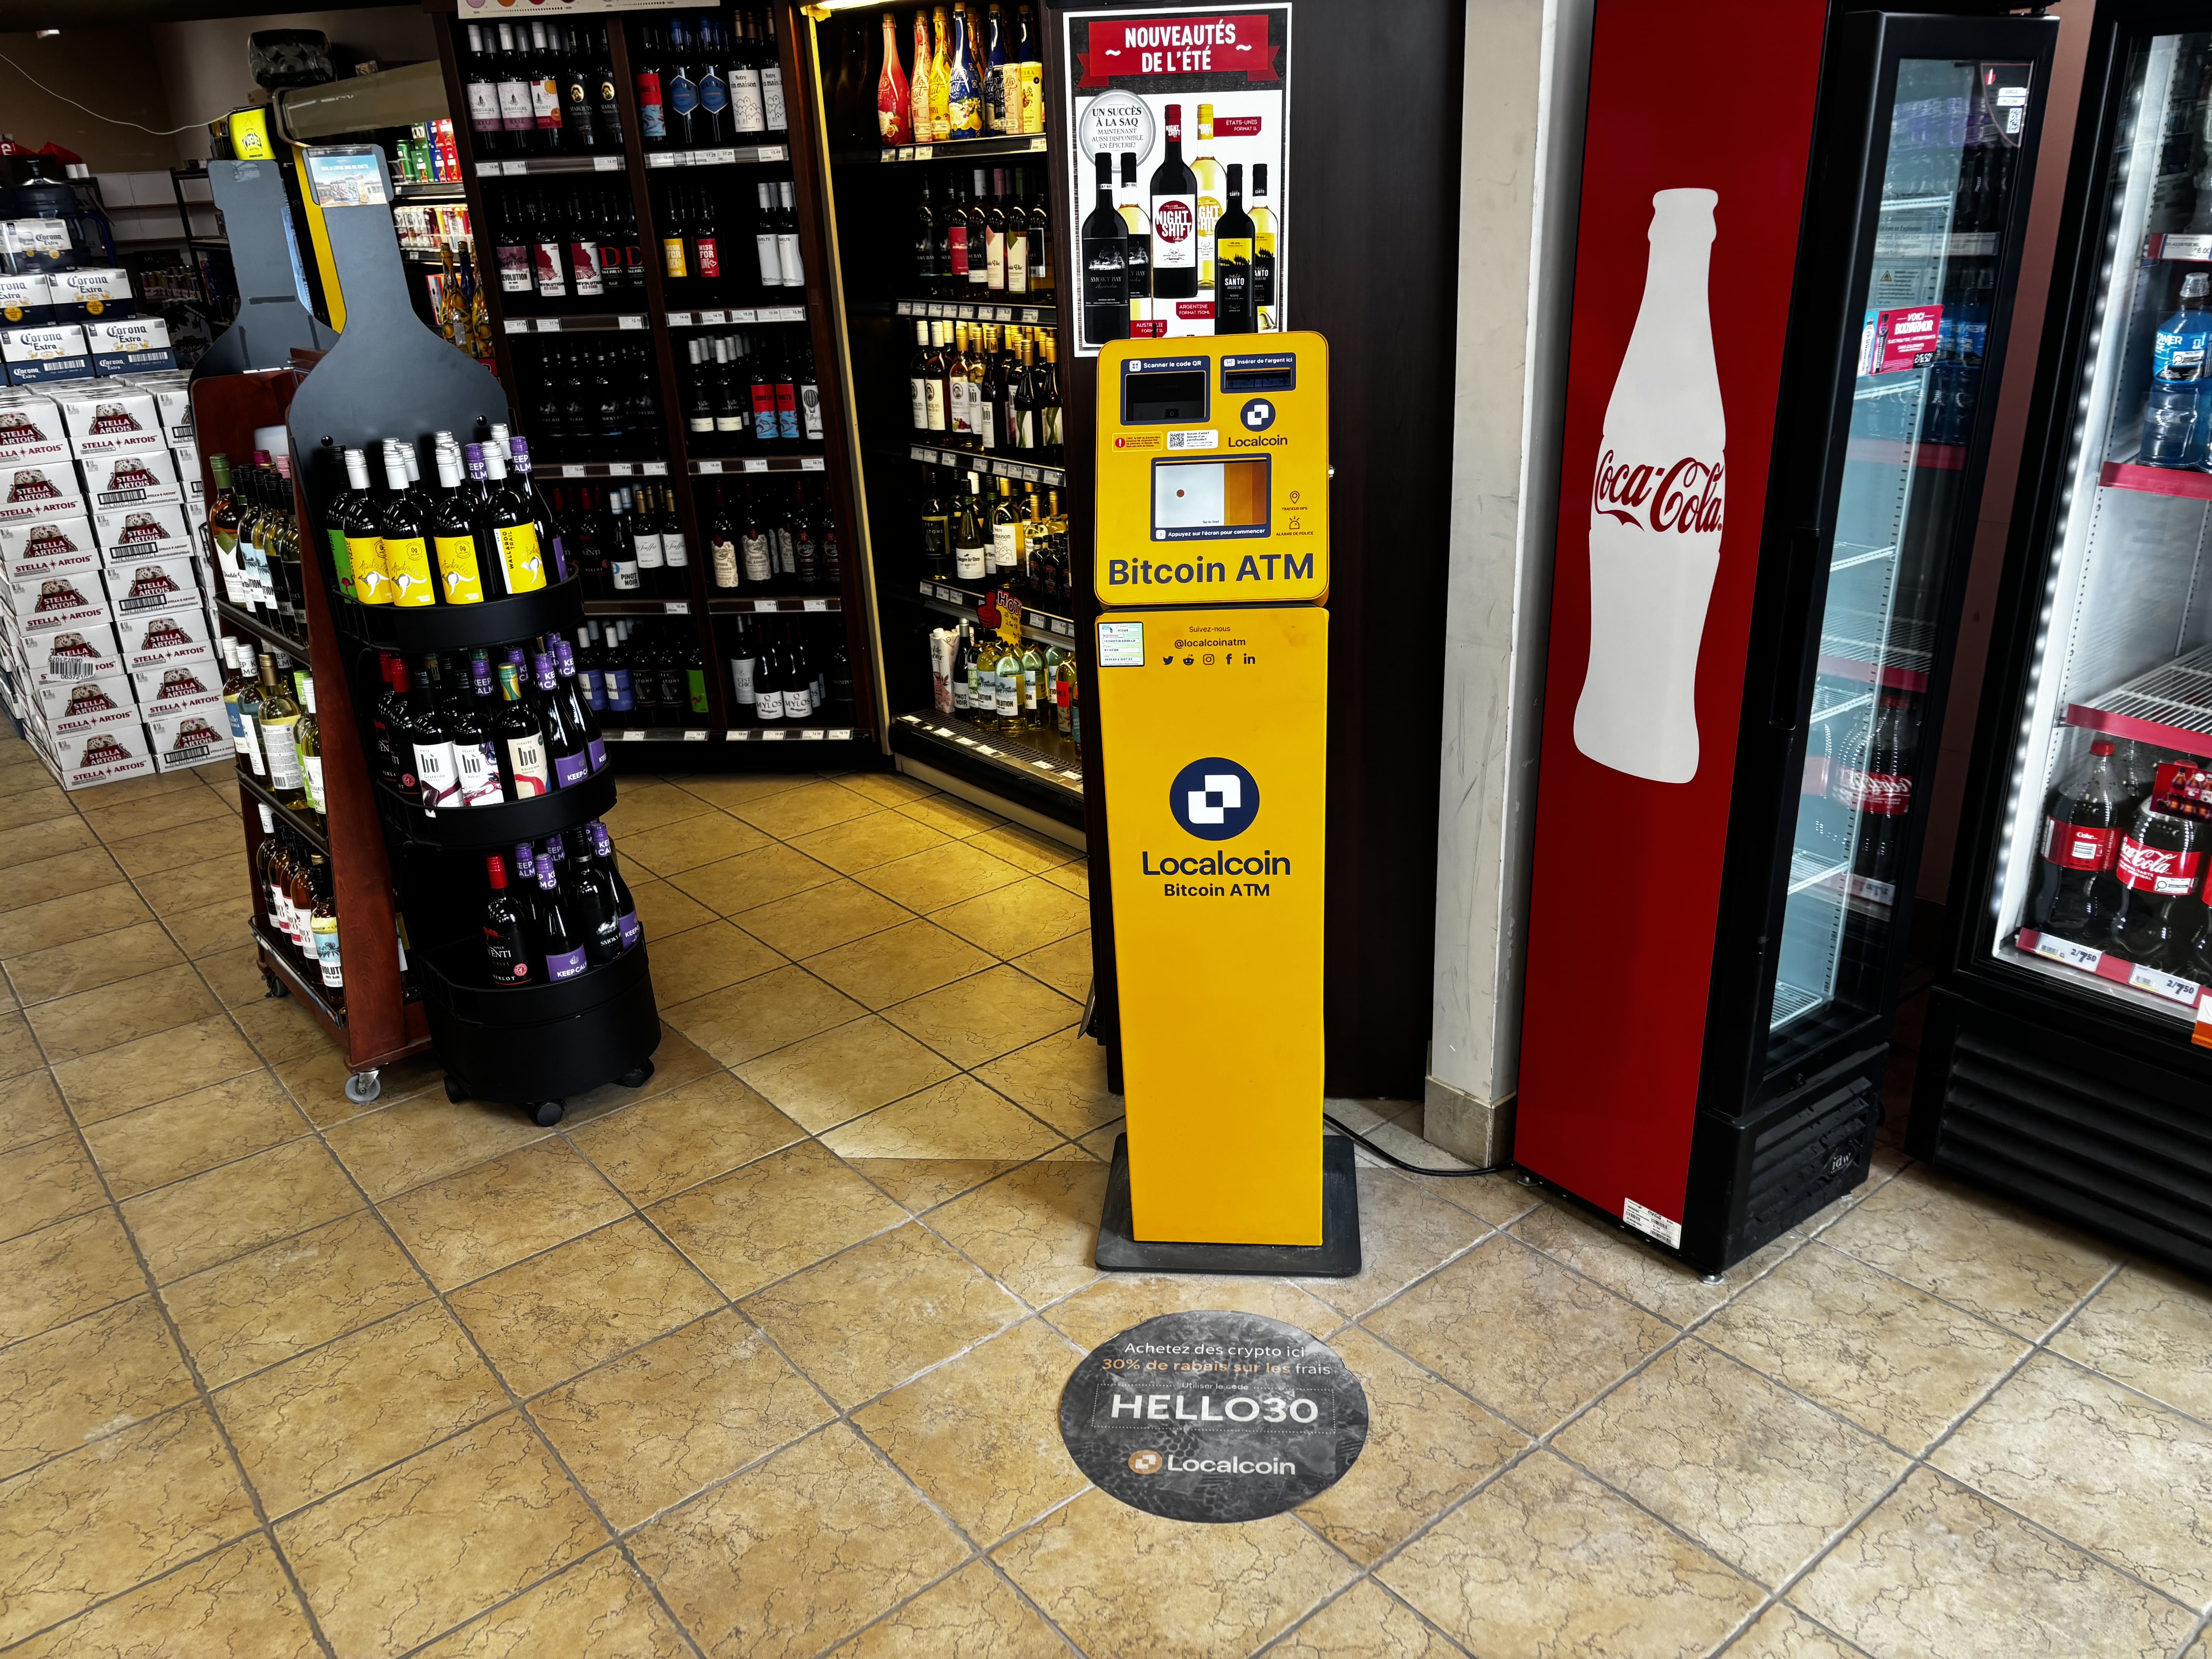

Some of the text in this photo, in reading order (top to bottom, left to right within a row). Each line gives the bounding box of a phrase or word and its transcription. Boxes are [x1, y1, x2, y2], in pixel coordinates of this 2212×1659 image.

[1125, 20, 1235, 48] NOUVEAUTÉS
[1142, 45, 1211, 73] DE L'ÉTÉ
[1092, 105, 1142, 117] UN SUCCÈS
[1096, 117, 1103, 127] À
[1120, 117, 1138, 127] SAQ
[1156, 211, 1188, 225] NIGHT
[1162, 223, 1192, 237] SHIFT
[67, 275, 109, 288] Corona
[1908, 312, 1925, 321] VOICI
[106, 325, 147, 338] Corona
[20, 332, 63, 346] Corona
[98, 419, 130, 428] STELLA
[100, 426, 132, 434] ARTOIS
[82, 436, 156, 449] STELLA ARTOIS
[1228, 434, 1288, 447] Localcoin
[1595, 450, 1724, 534] Coca-Cola
[0, 502, 76, 517] STELLA ARTOIS
[502, 531, 514, 569] WALLAROO
[15, 556, 91, 572] STELLA ARTOIS
[1109, 553, 1314, 585] Bitcoin ATM
[620, 572, 637, 580] PINOT
[998, 591, 1022, 617] HOT!
[1175, 639, 1246, 649] @localcoinatm
[134, 647, 204, 663] STELLA ARTOIS
[150, 696, 219, 713] STELLA ARTOIS
[756, 700, 782, 708] MYLOS
[518, 745, 537, 766] bù
[421, 754, 439, 773] bù
[567, 771, 583, 781] KEEP
[1142, 850, 1291, 876] Localcoin
[1164, 884, 1270, 897] Bitcoin ATM
[488, 947, 511, 958] VENTI
[557, 960, 587, 977] KEEP CALM
[1125, 1343, 1304, 1359] Achetez des crypto ici
[1102, 1358, 1331, 1375] 30% de rabais sur les frais
[1111, 1394, 1318, 1423] HELLO30
[1168, 1454, 1295, 1475] Localcoin
